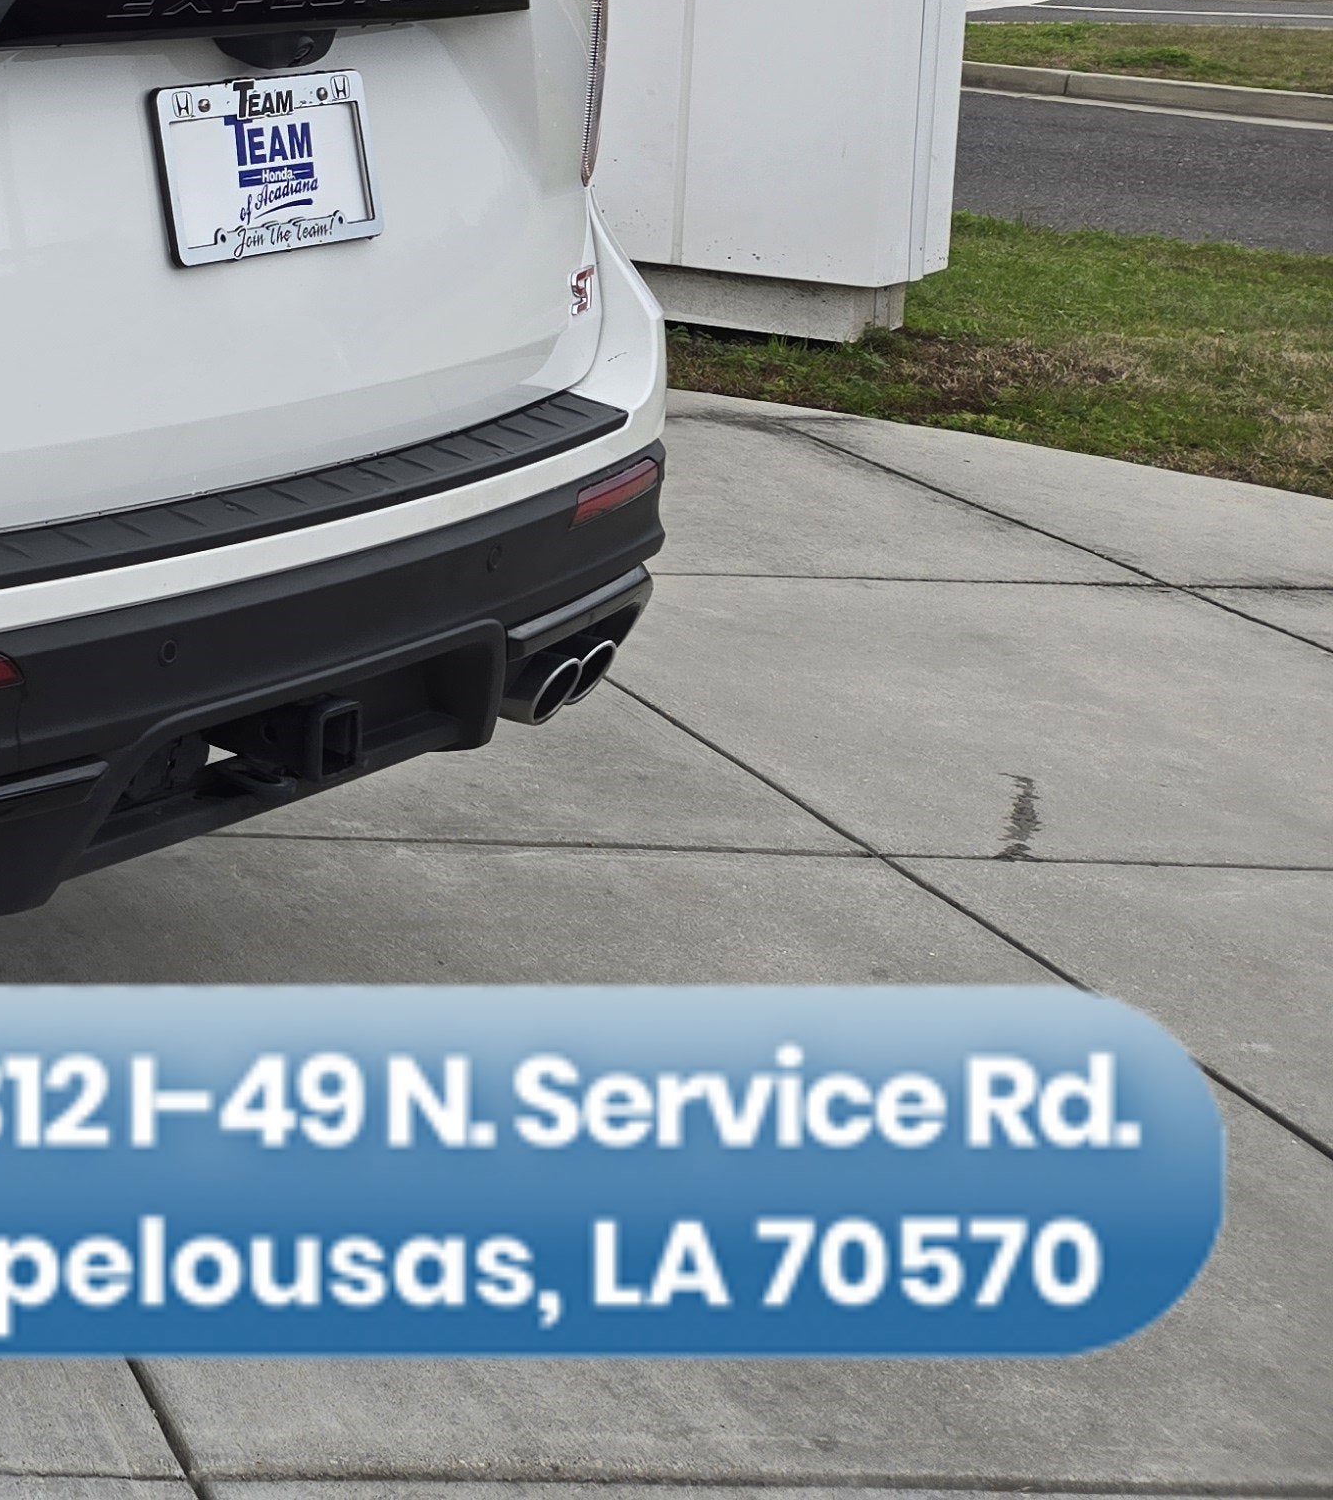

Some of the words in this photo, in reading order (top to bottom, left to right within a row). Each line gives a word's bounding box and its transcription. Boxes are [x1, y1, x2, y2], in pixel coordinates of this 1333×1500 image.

[233, 80, 294, 118] TEAM
[224, 115, 314, 167] TEAM
[261, 167, 294, 184] Honda
[240, 193, 253, 226] of
[254, 177, 319, 211] Acadiana
[233, 227, 264, 258] Join
[265, 222, 292, 246] The
[292, 216, 335, 242] Team!
